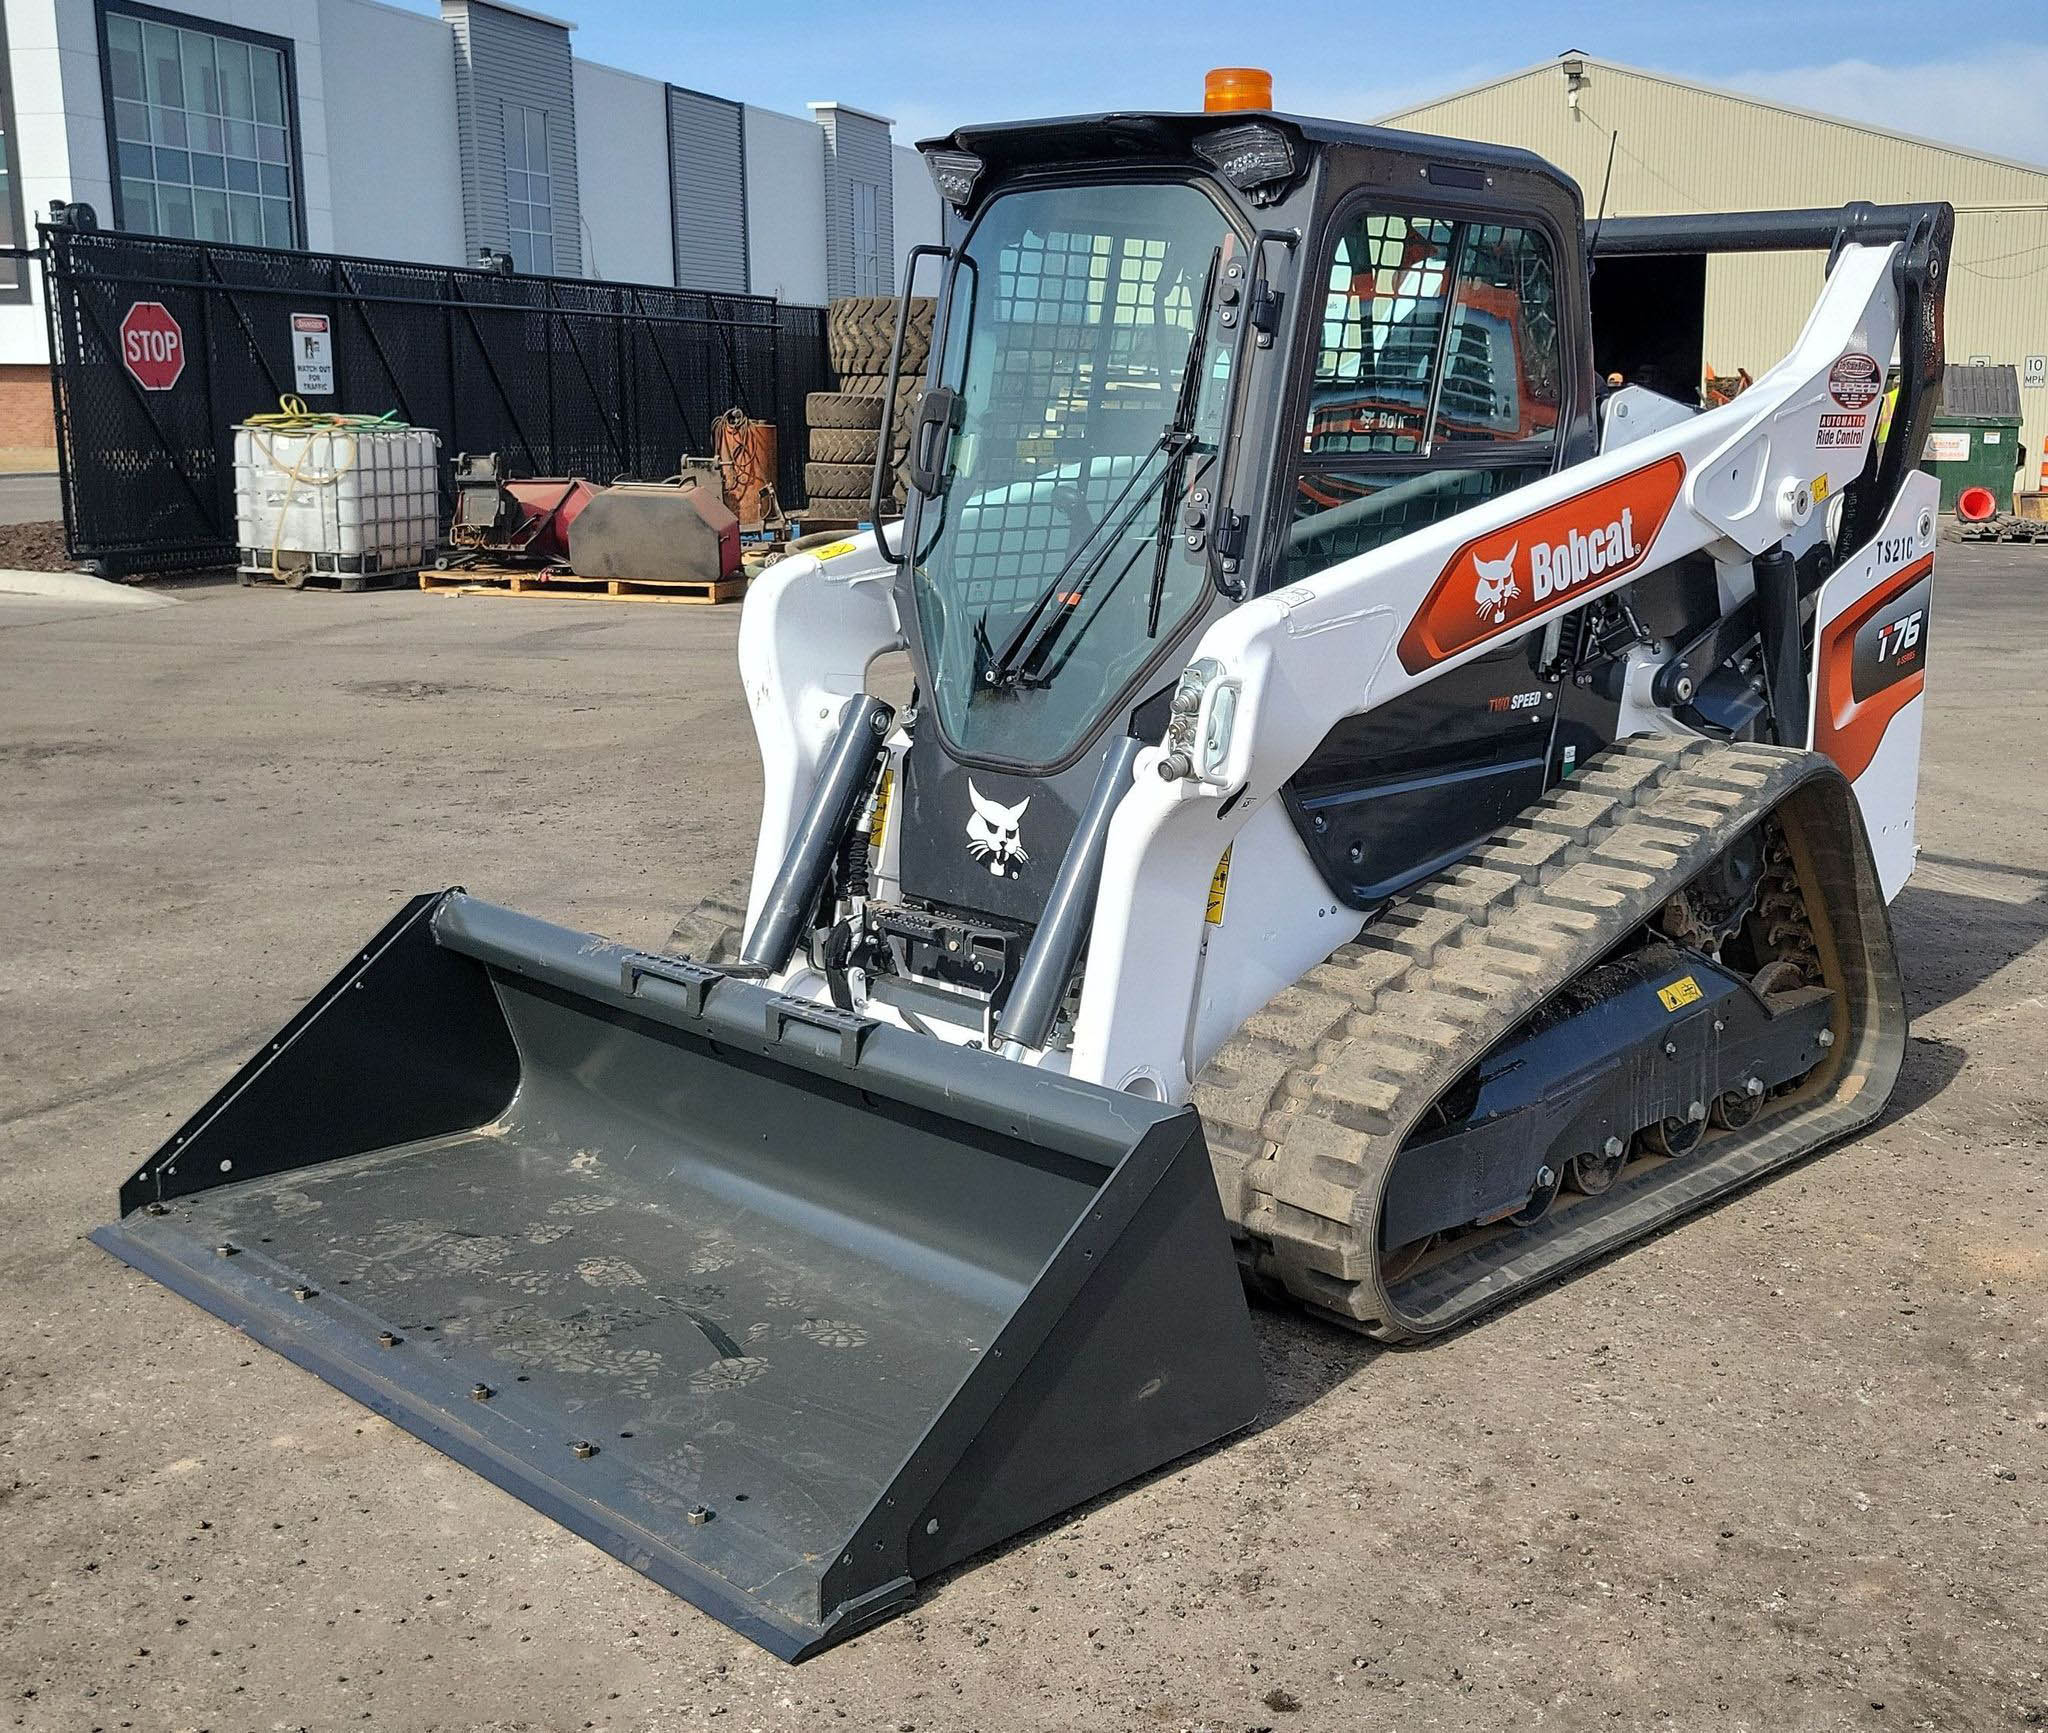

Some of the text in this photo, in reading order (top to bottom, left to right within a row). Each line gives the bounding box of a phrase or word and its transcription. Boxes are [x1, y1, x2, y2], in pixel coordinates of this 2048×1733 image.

[127, 330, 178, 362] STOP
[2029, 359, 2043, 371] 10
[303, 383, 328, 391] TRAFFIC
[2025, 376, 2044, 384] MPH
[1820, 415, 1865, 427] AUTOMATIC
[1816, 429, 1865, 445] Ride Control
[1531, 507, 1635, 602] Bobcat
[1877, 536, 1913, 565] TS21C
[1878, 609, 1923, 663] T76
[1489, 691, 1542, 711] TWO SPEED
